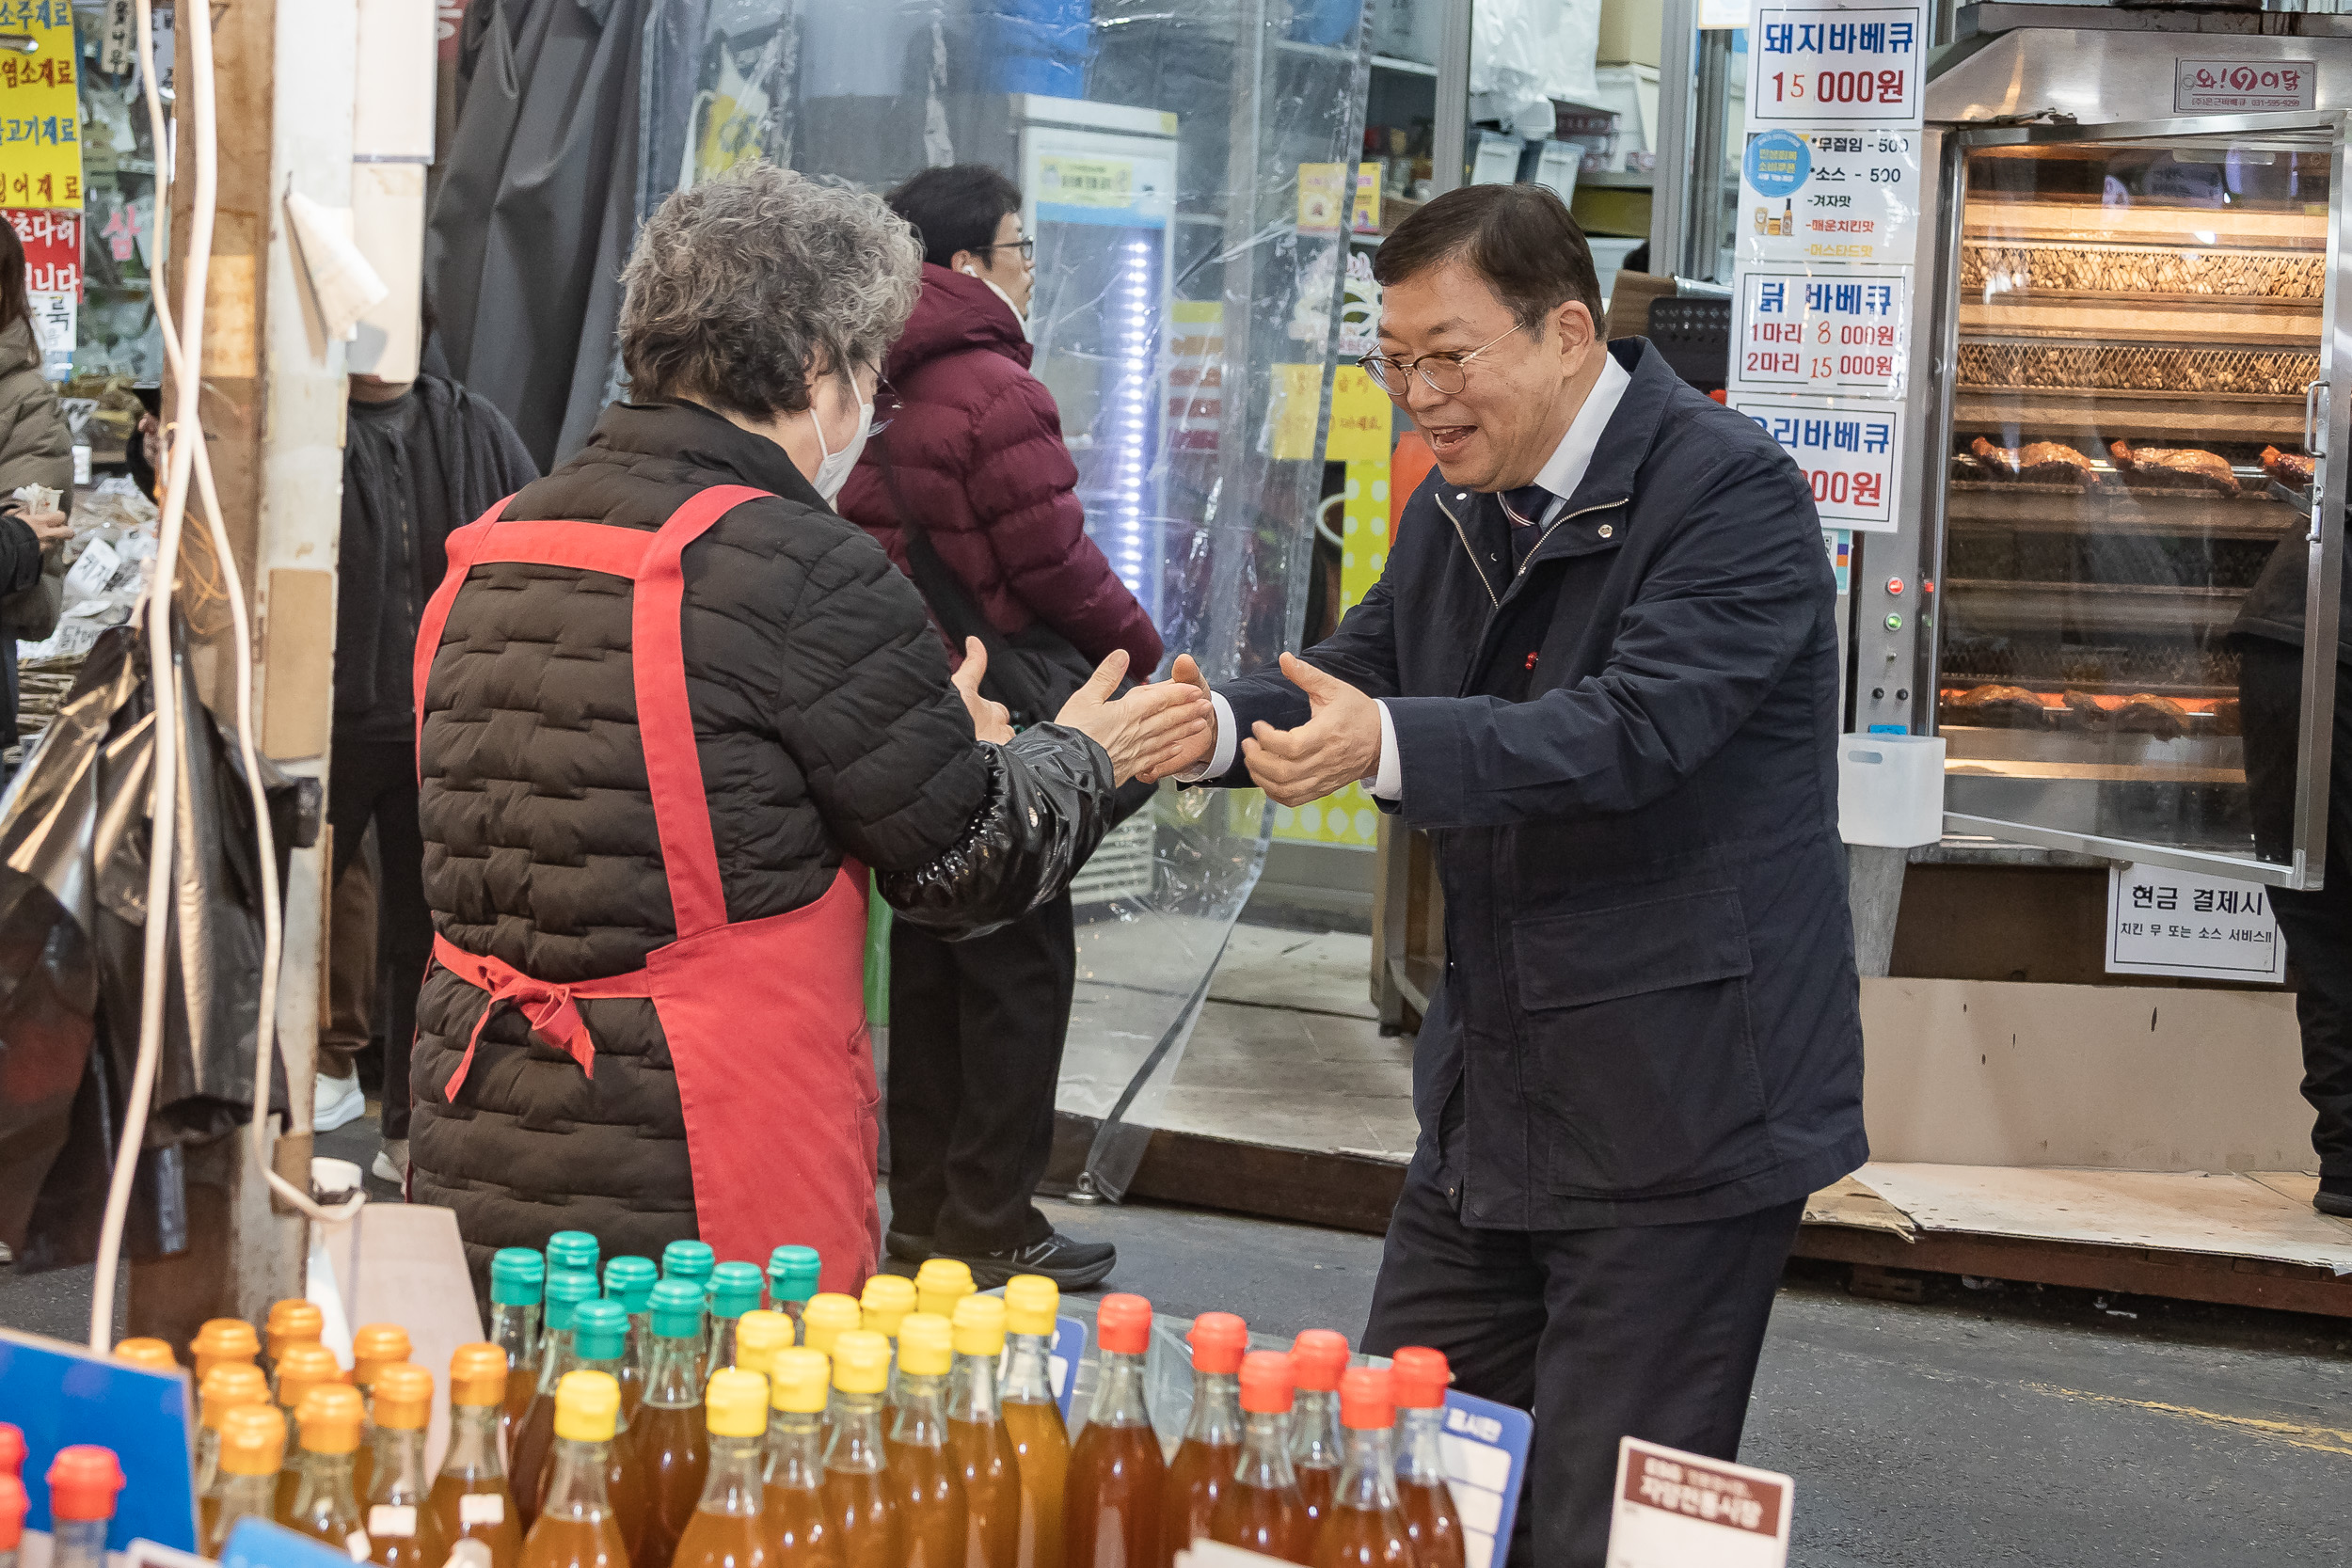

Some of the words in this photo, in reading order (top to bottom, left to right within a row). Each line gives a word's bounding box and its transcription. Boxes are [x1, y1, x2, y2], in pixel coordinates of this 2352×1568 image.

[1764, 23, 1914, 54] 돼지바베큐
[1817, 70, 1904, 103] 000원
[0, 115, 77, 146] 고기재료
[1870, 167, 1901, 182] 500
[24, 262, 80, 292] 니다
[1759, 283, 1785, 312] 닭
[1805, 283, 1891, 315] 바베큐
[1753, 323, 1802, 343] 1마리
[1817, 321, 1832, 344] 8
[1840, 325, 1894, 346] 000원
[1746, 352, 1800, 373] 2마리
[1809, 356, 1833, 378] 15
[1839, 356, 1893, 376] 000원
[1801, 468, 1882, 507] 00원
[2132, 885, 2178, 911] 현금
[2193, 888, 2263, 915] 결제시
[2121, 923, 2143, 936] 치킨
[2150, 924, 2161, 937] 무
[2169, 925, 2191, 939] 또는
[2198, 927, 2222, 940] 소스
[2229, 928, 2272, 942] 서비스!!
